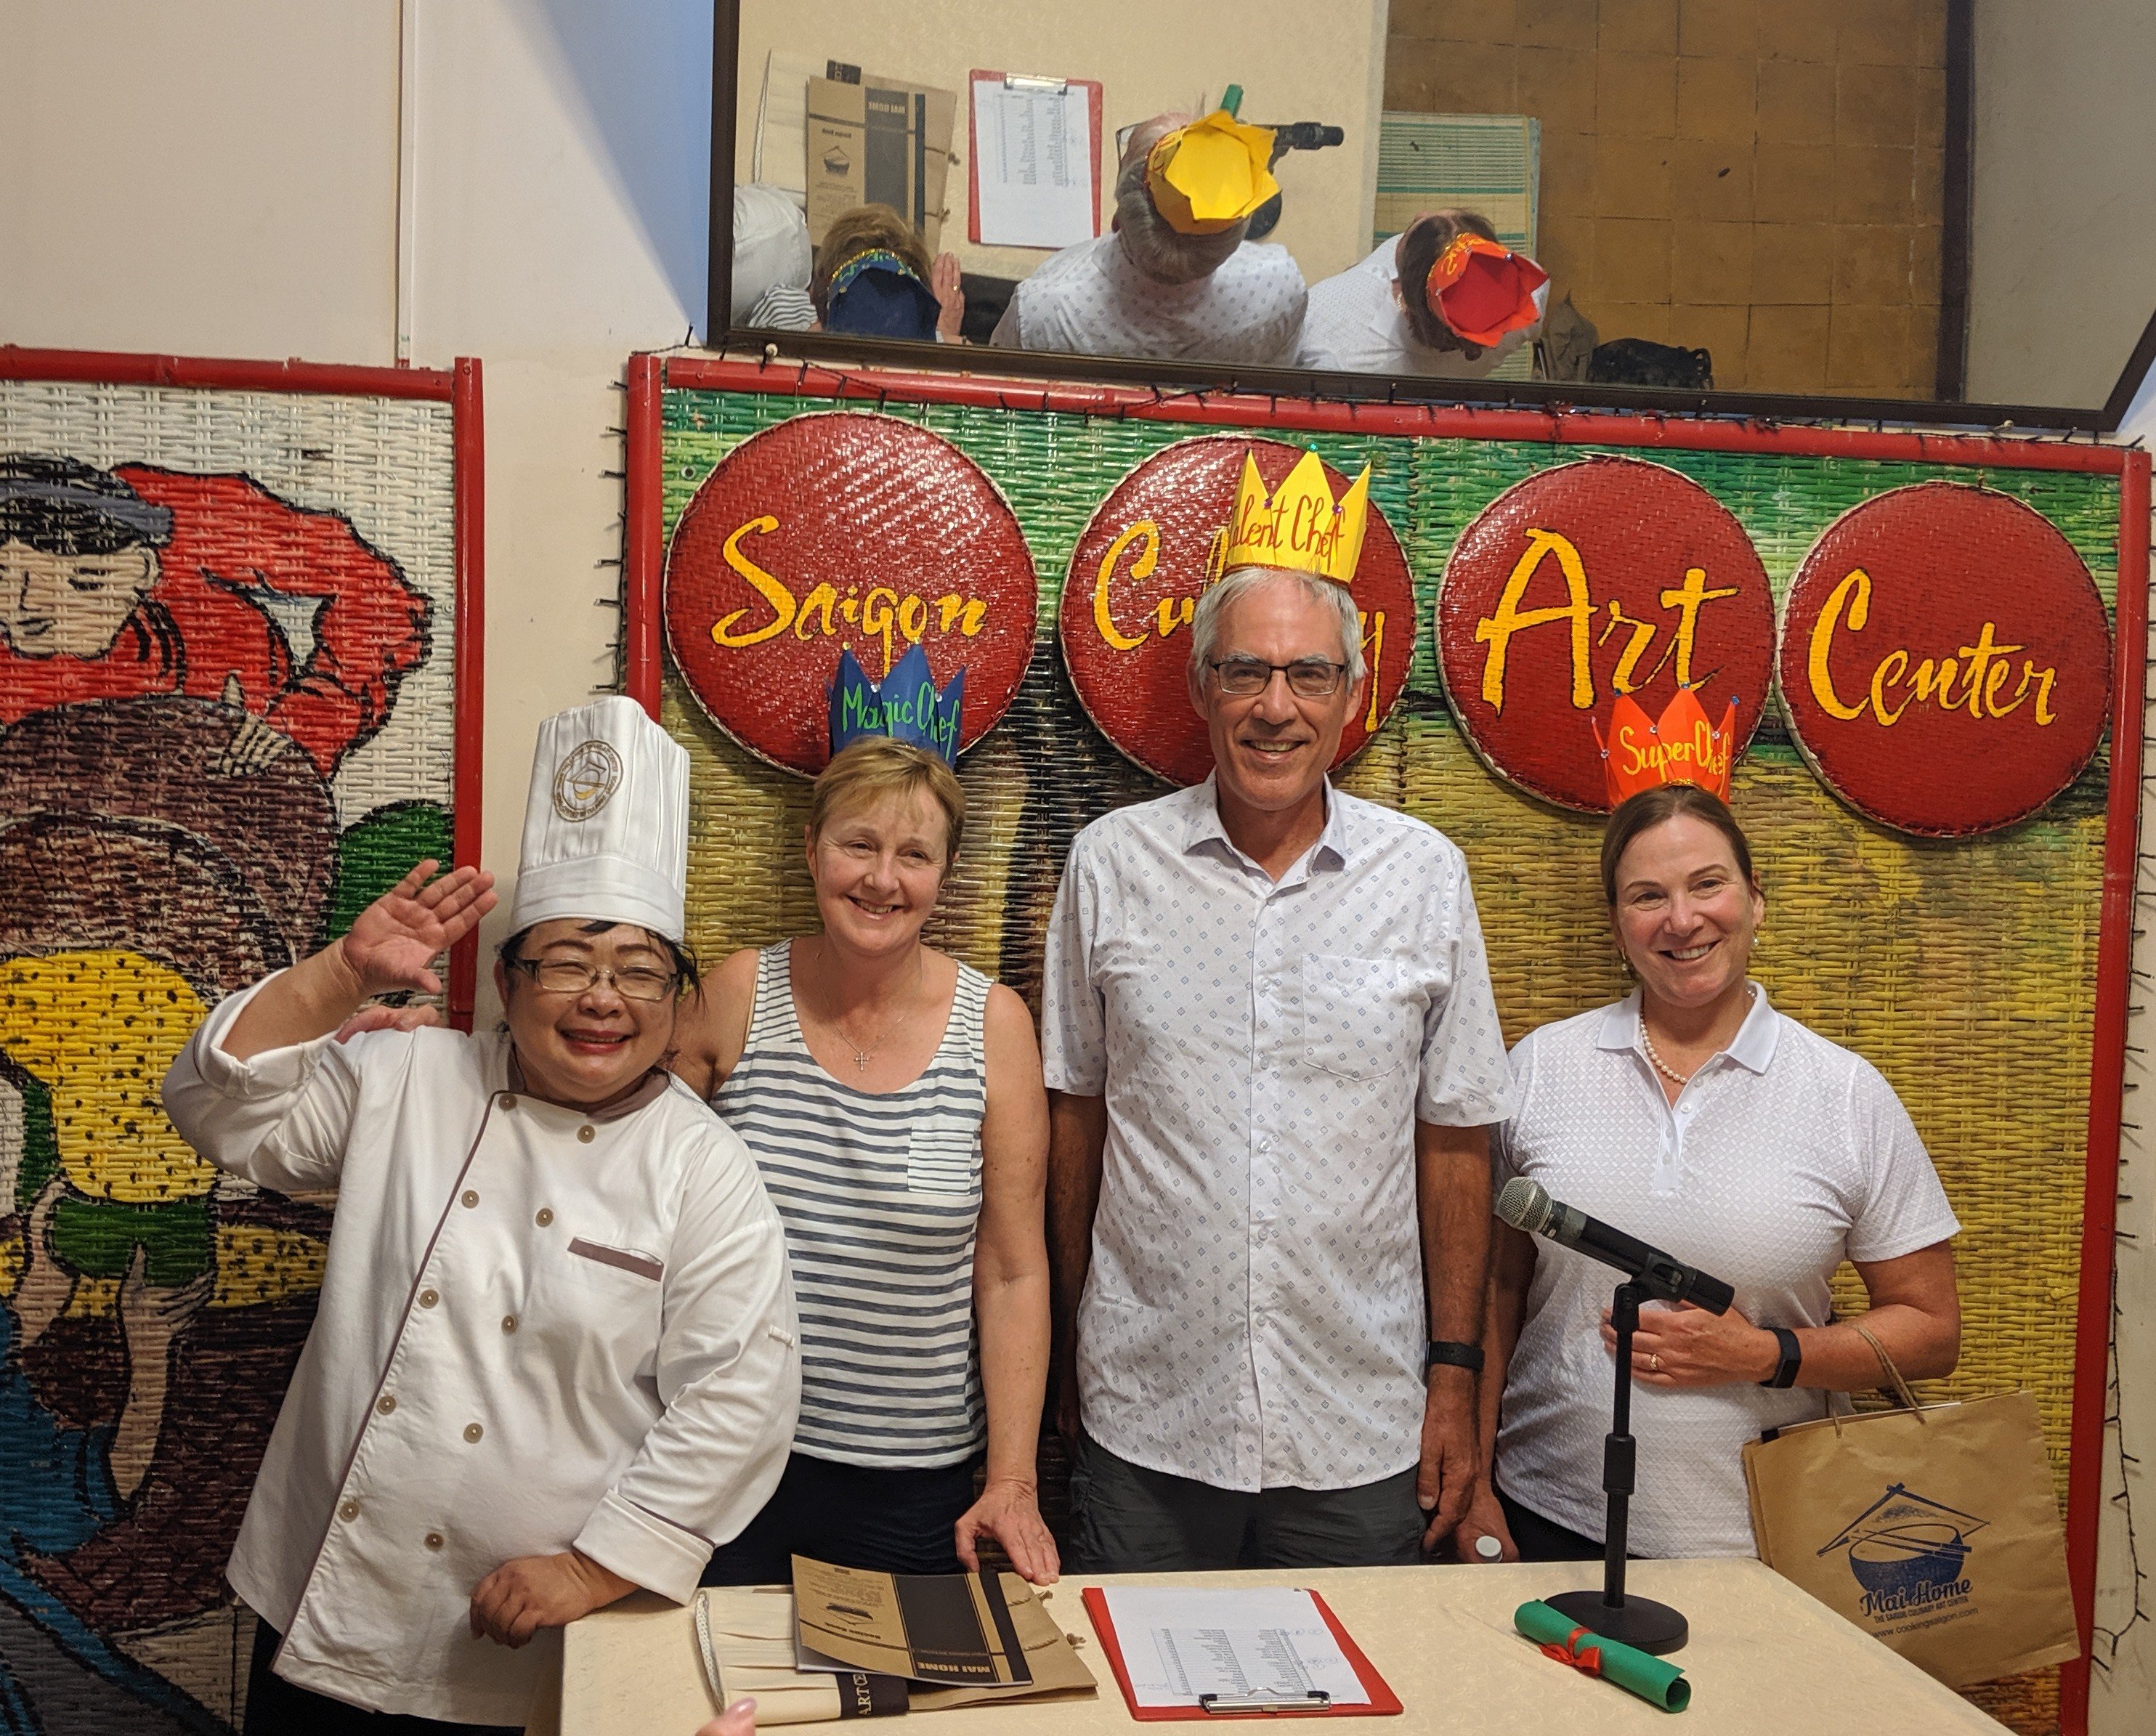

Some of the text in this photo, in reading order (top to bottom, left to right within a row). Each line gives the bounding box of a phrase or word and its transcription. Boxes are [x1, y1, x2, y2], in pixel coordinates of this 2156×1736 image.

[1292, 495, 1346, 573] Chef
[711, 514, 988, 678] Saigon
[1475, 527, 1739, 716] Art
[1807, 567, 2056, 726] Center
[843, 681, 960, 760] Magic Chef
[1619, 726, 1695, 782] Super
[1860, 1579, 1974, 1617] Mai Home
[917, 1660, 992, 1674] MAI HOME
